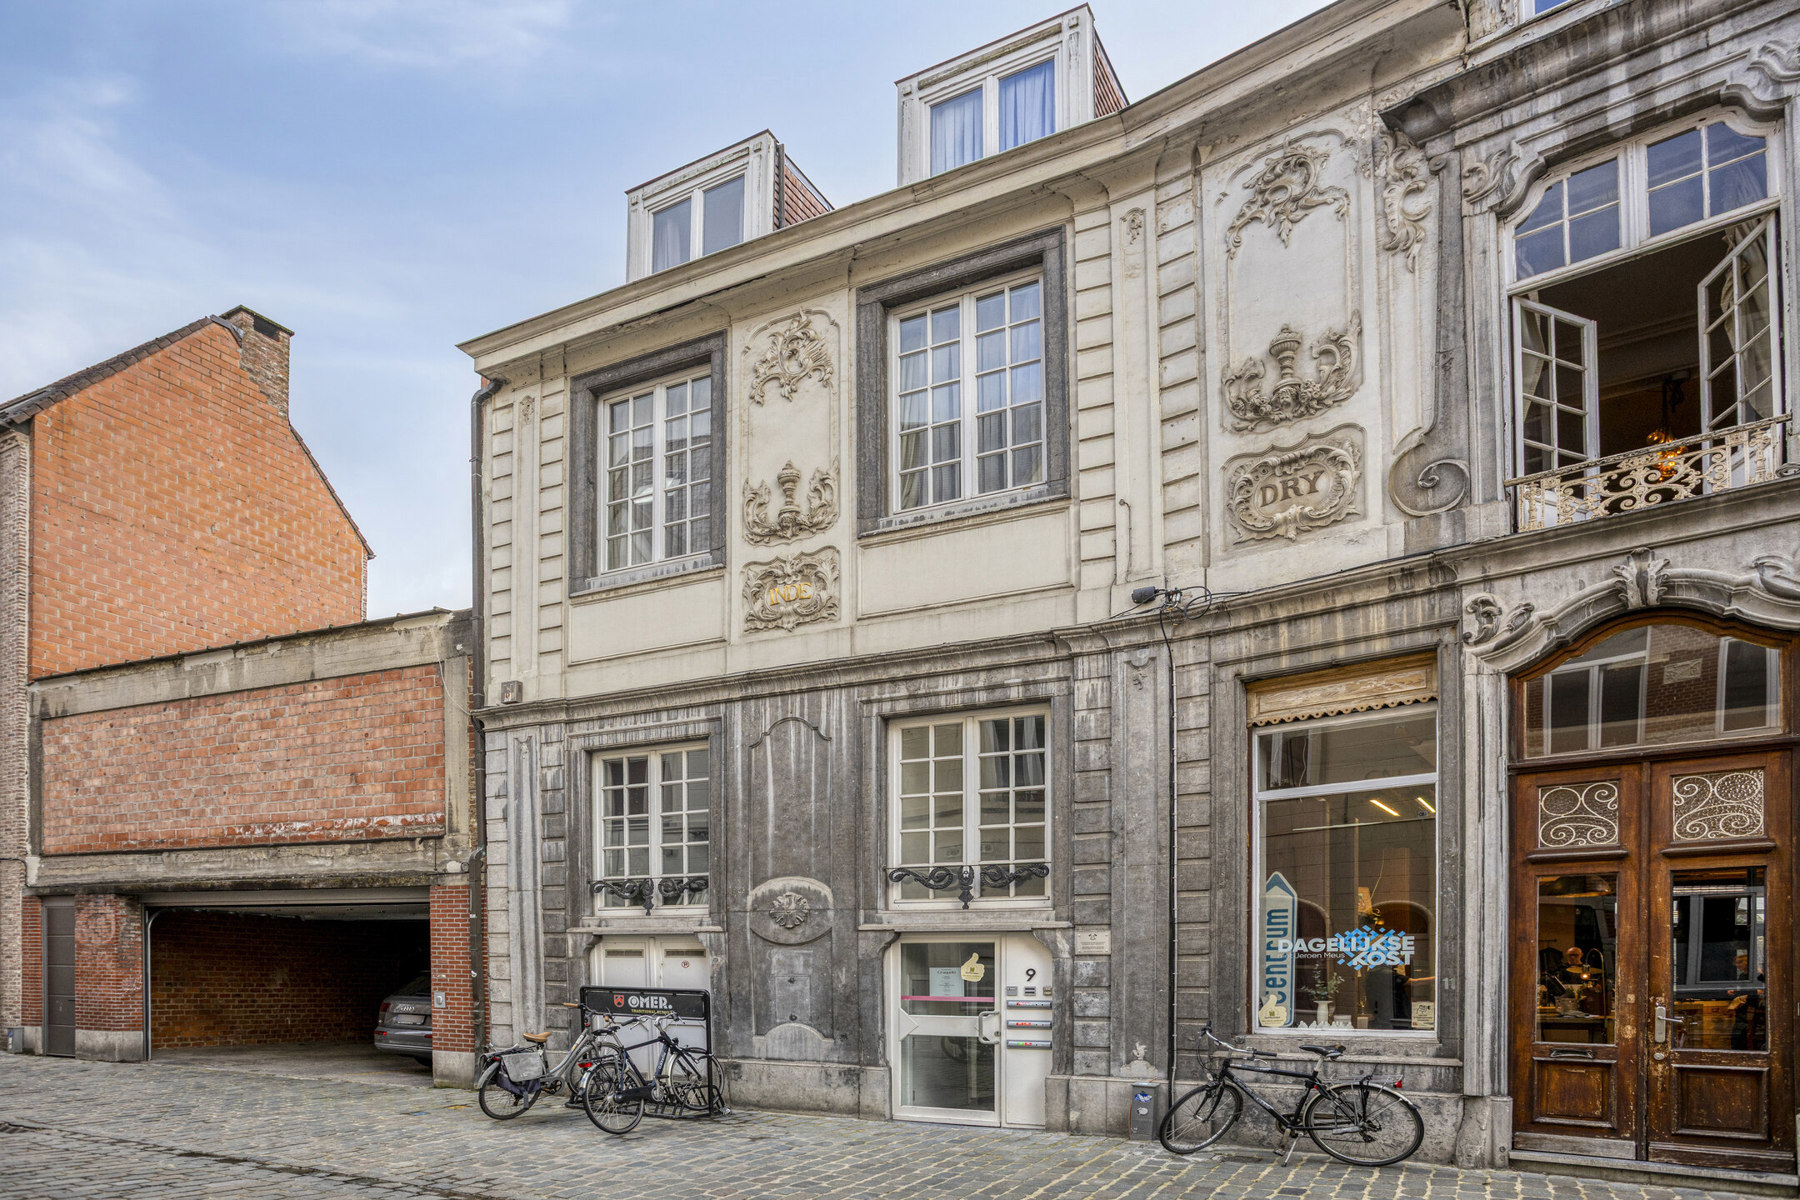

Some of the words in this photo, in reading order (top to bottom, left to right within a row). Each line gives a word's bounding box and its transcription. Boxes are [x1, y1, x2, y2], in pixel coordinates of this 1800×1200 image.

[1259, 469, 1325, 508] DRY
[769, 581, 812, 606] INDE
[1277, 936, 1415, 953] DAGELIJKSE
[1352, 950, 1415, 966] KOST
[1025, 968, 1037, 982] 9
